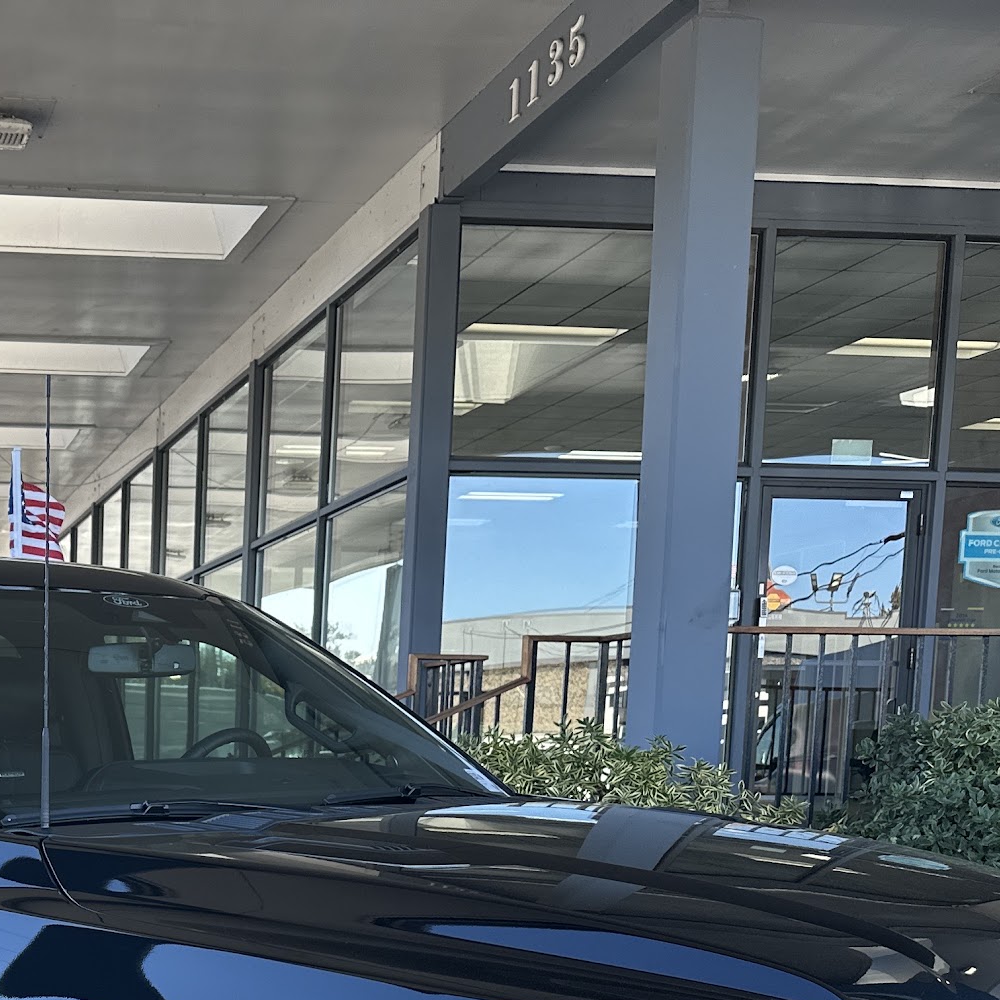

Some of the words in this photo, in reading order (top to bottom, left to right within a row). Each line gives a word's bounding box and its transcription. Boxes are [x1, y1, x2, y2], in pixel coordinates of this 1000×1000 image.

[507, 14, 586, 123] 1135
[968, 539, 992, 547] FORD
[111, 596, 143, 607] Ford
